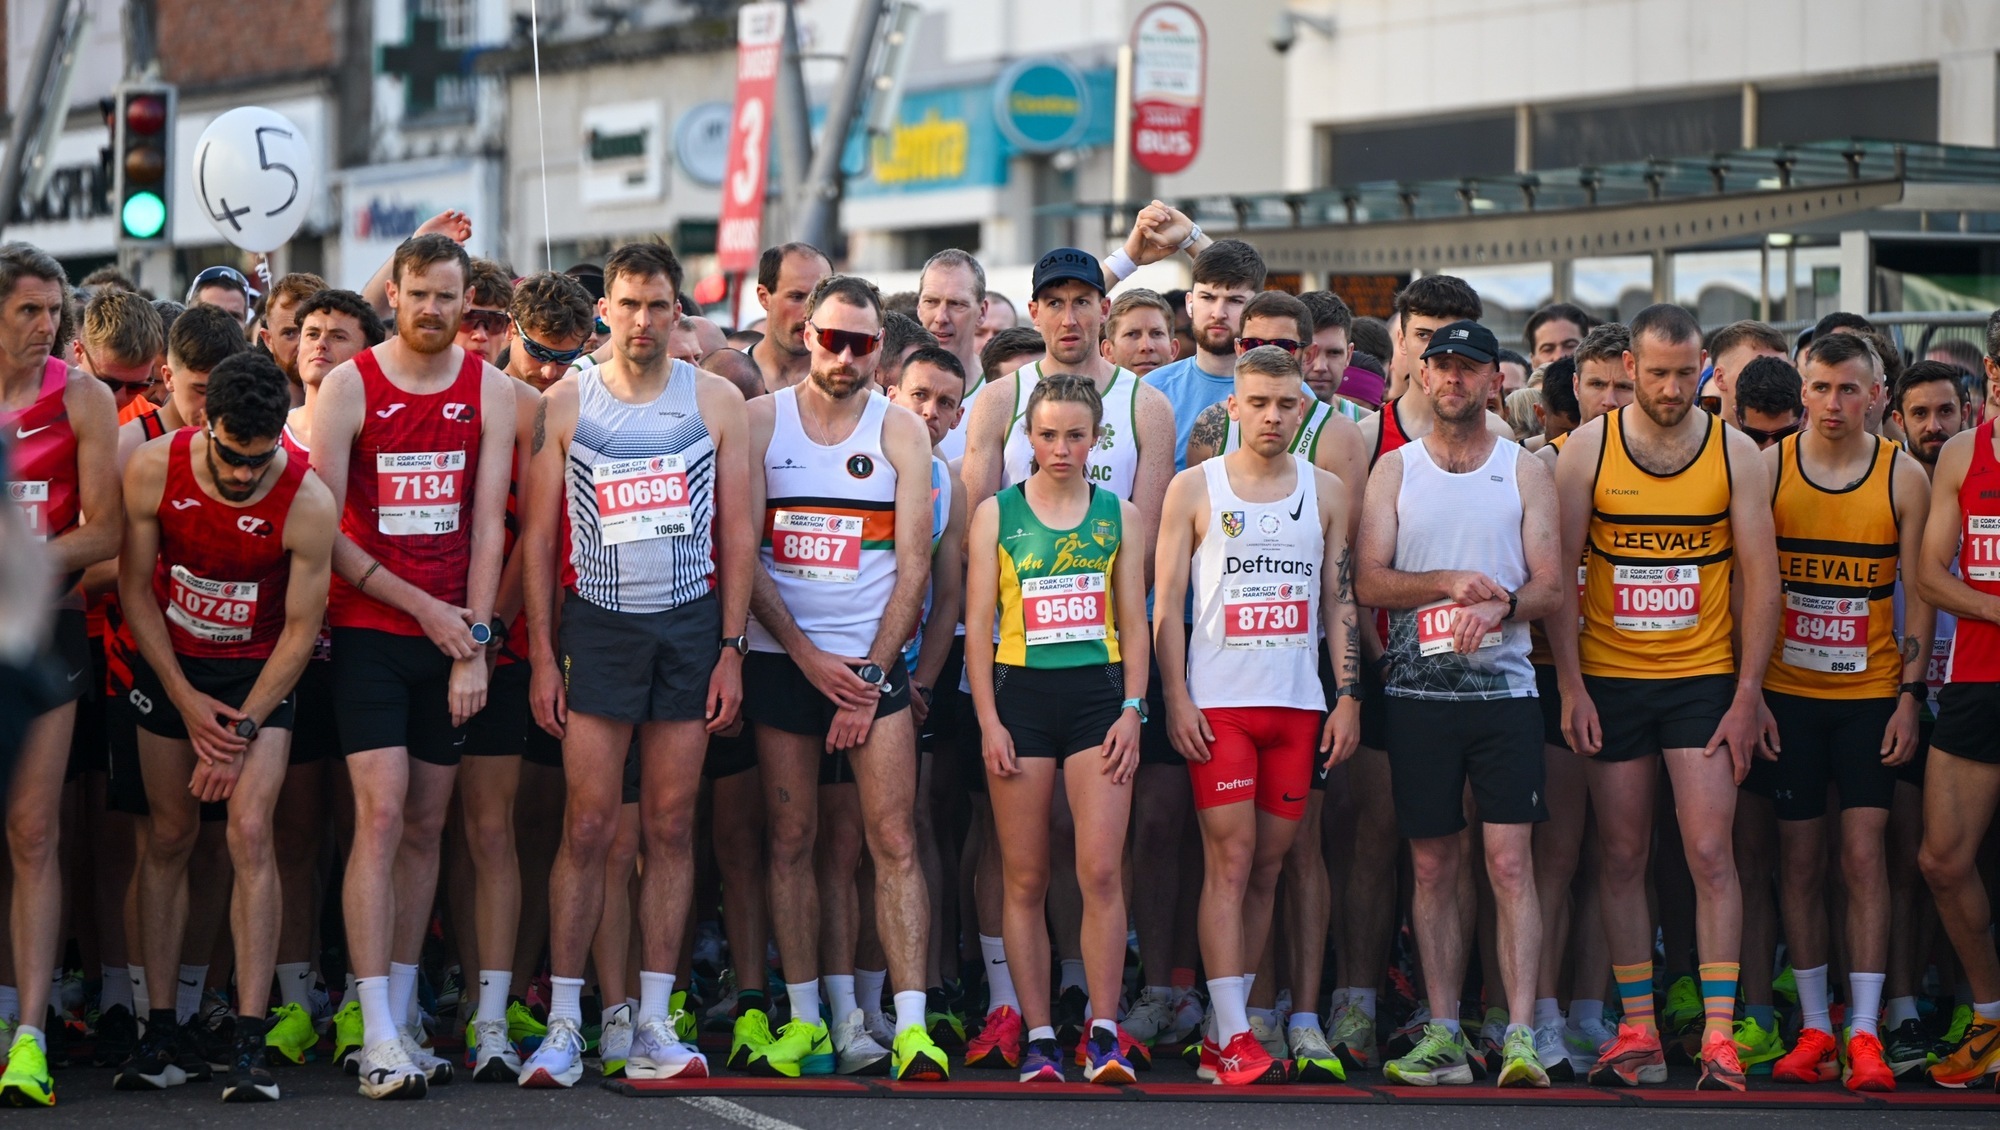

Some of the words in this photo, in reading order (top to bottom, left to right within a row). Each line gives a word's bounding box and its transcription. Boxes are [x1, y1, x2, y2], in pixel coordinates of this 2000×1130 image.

[732, 97, 765, 206] 3
[1136, 128, 1192, 156] BUS
[1040, 253, 1088, 269] CA-014
[1298, 427, 1314, 454] soar
[611, 462, 631, 470] CORK
[632, 460, 647, 468] CITY
[612, 466, 647, 475] MARATHON
[1090, 465, 1112, 481] AC
[391, 474, 455, 500] 7134
[602, 476, 683, 510] 10696
[1611, 488, 1639, 496] KUKRI
[434, 520, 454, 531] 7134
[654, 523, 685, 535] 10696
[790, 520, 824, 528] MARATHON
[783, 534, 848, 562] 8867
[1613, 530, 1712, 551] LEEVALE
[1016, 552, 1045, 574] An
[1778, 555, 1880, 583] LEEVALE
[174, 584, 250, 623] 10748
[1619, 587, 1695, 611] 10900
[1801, 596, 1819, 604] CORK
[1801, 602, 1835, 610] MARATHON
[1036, 596, 1097, 624] 9568
[1238, 605, 1299, 630] 8730
[210, 634, 243, 642] 10748
[1795, 615, 1856, 642] 8945
[1831, 661, 1856, 671] 8945
